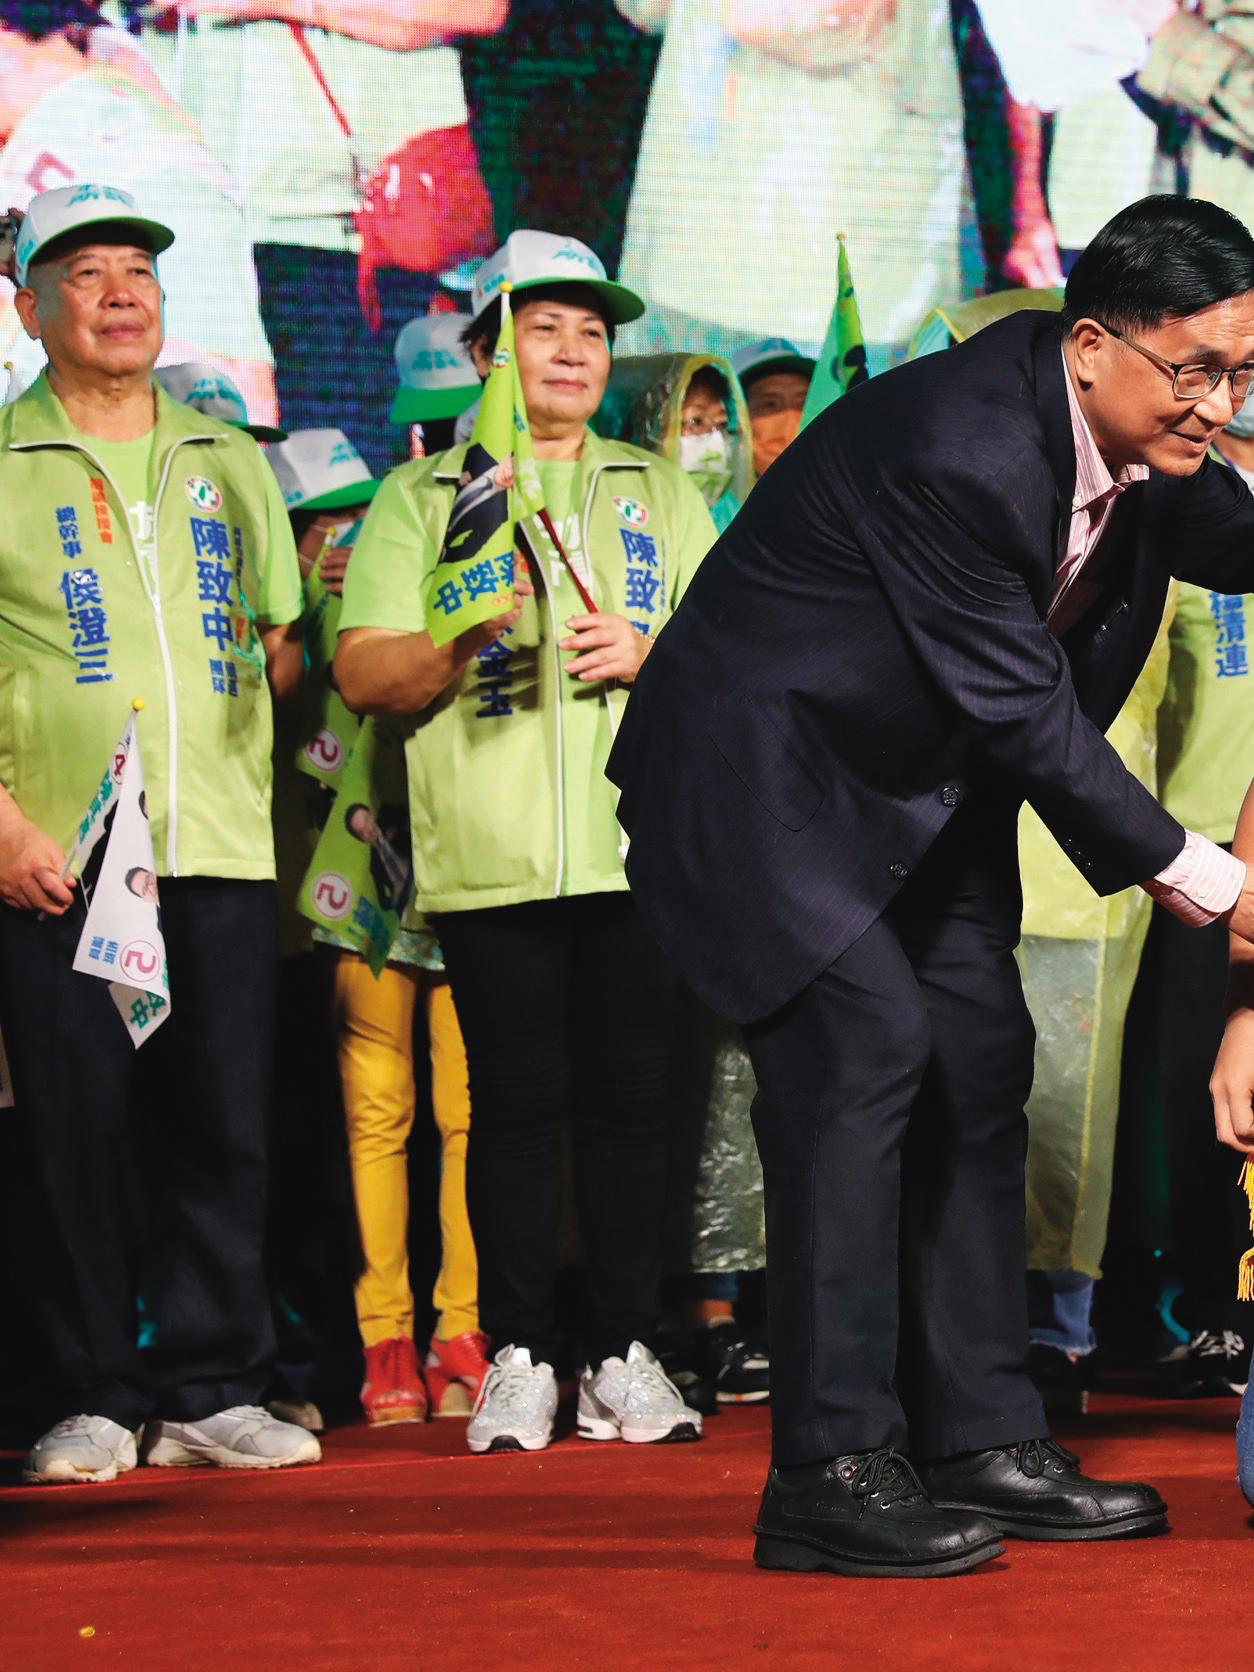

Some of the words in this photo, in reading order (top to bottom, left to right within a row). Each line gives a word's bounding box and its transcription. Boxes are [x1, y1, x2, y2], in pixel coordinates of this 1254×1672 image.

[190, 516, 234, 652] 陳致中
[475, 626, 513, 718] 金玉
